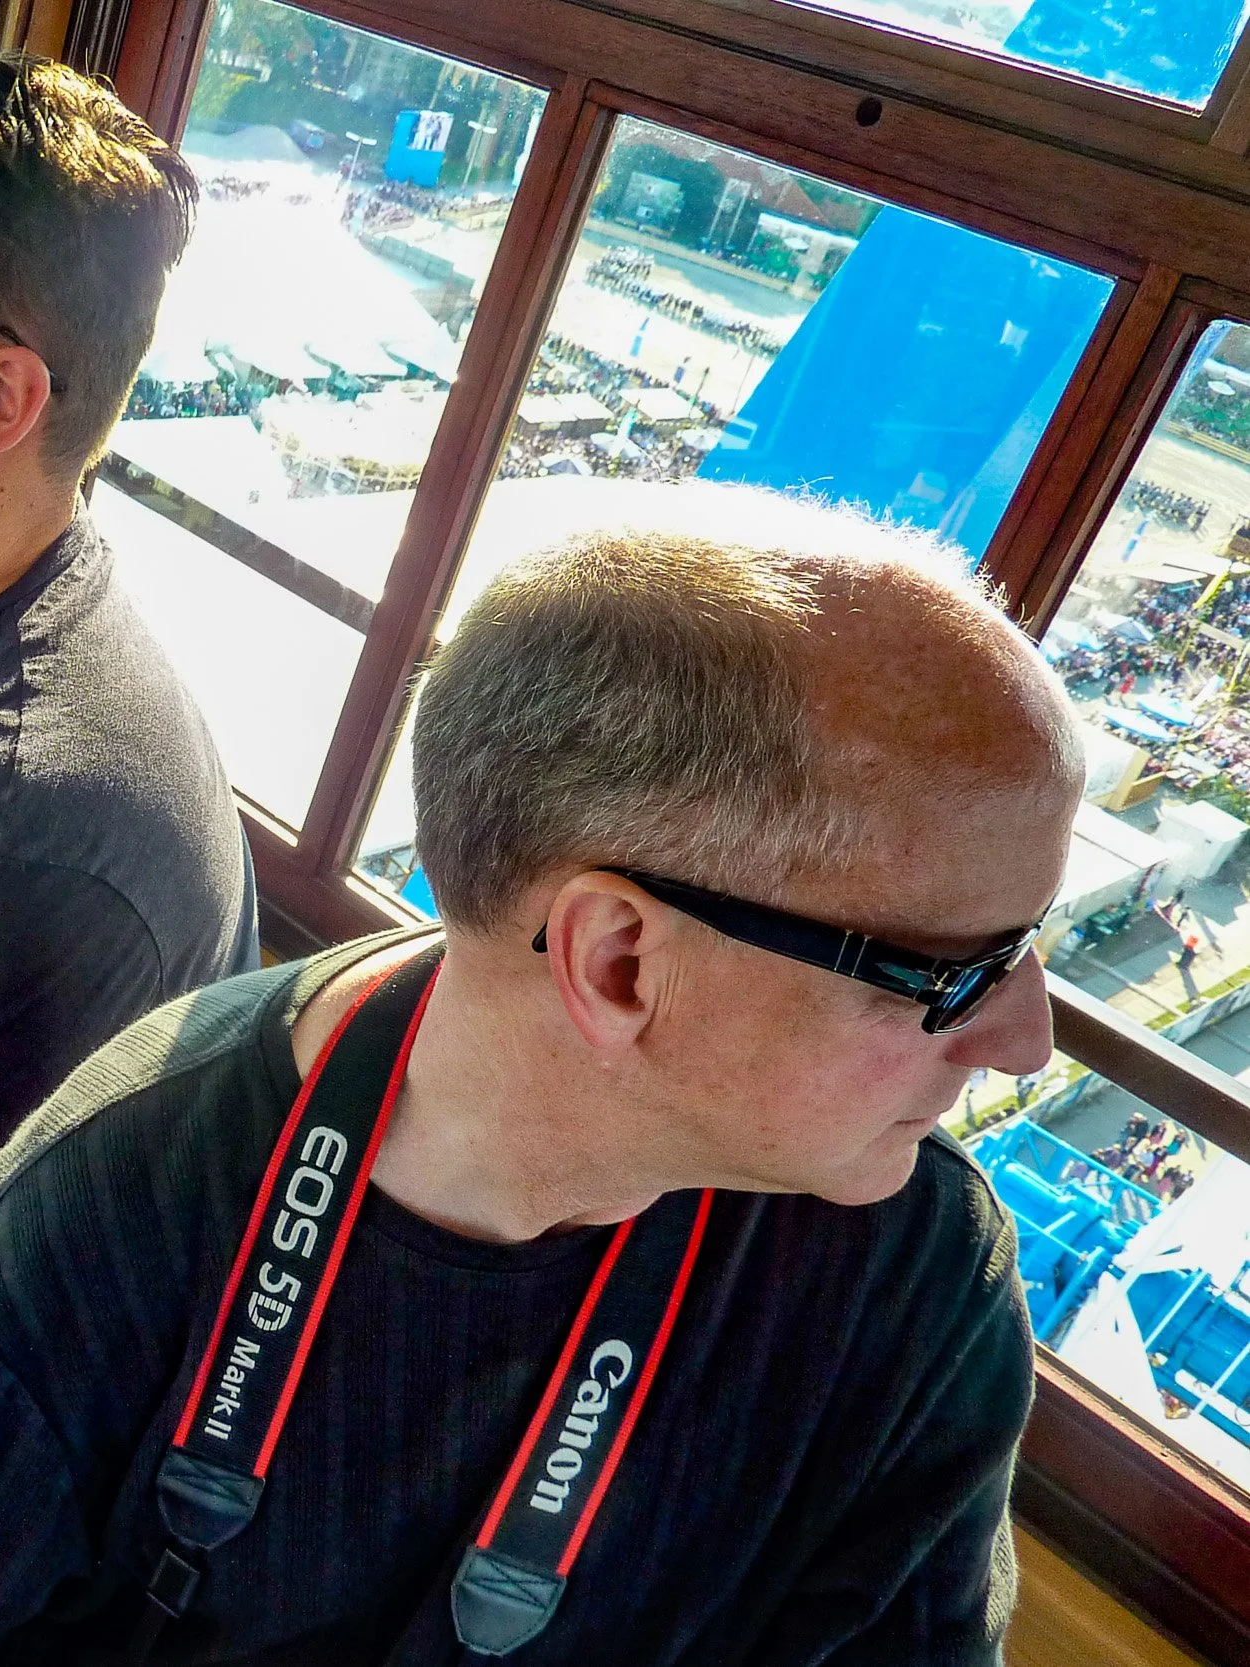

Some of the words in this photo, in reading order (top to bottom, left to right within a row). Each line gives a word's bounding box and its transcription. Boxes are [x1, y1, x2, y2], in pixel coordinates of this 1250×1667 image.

[271, 1125, 349, 1260] EOS
[247, 1260, 303, 1332] 5D
[211, 1335, 261, 1418] Mark
[529, 1338, 634, 1515] Canon
